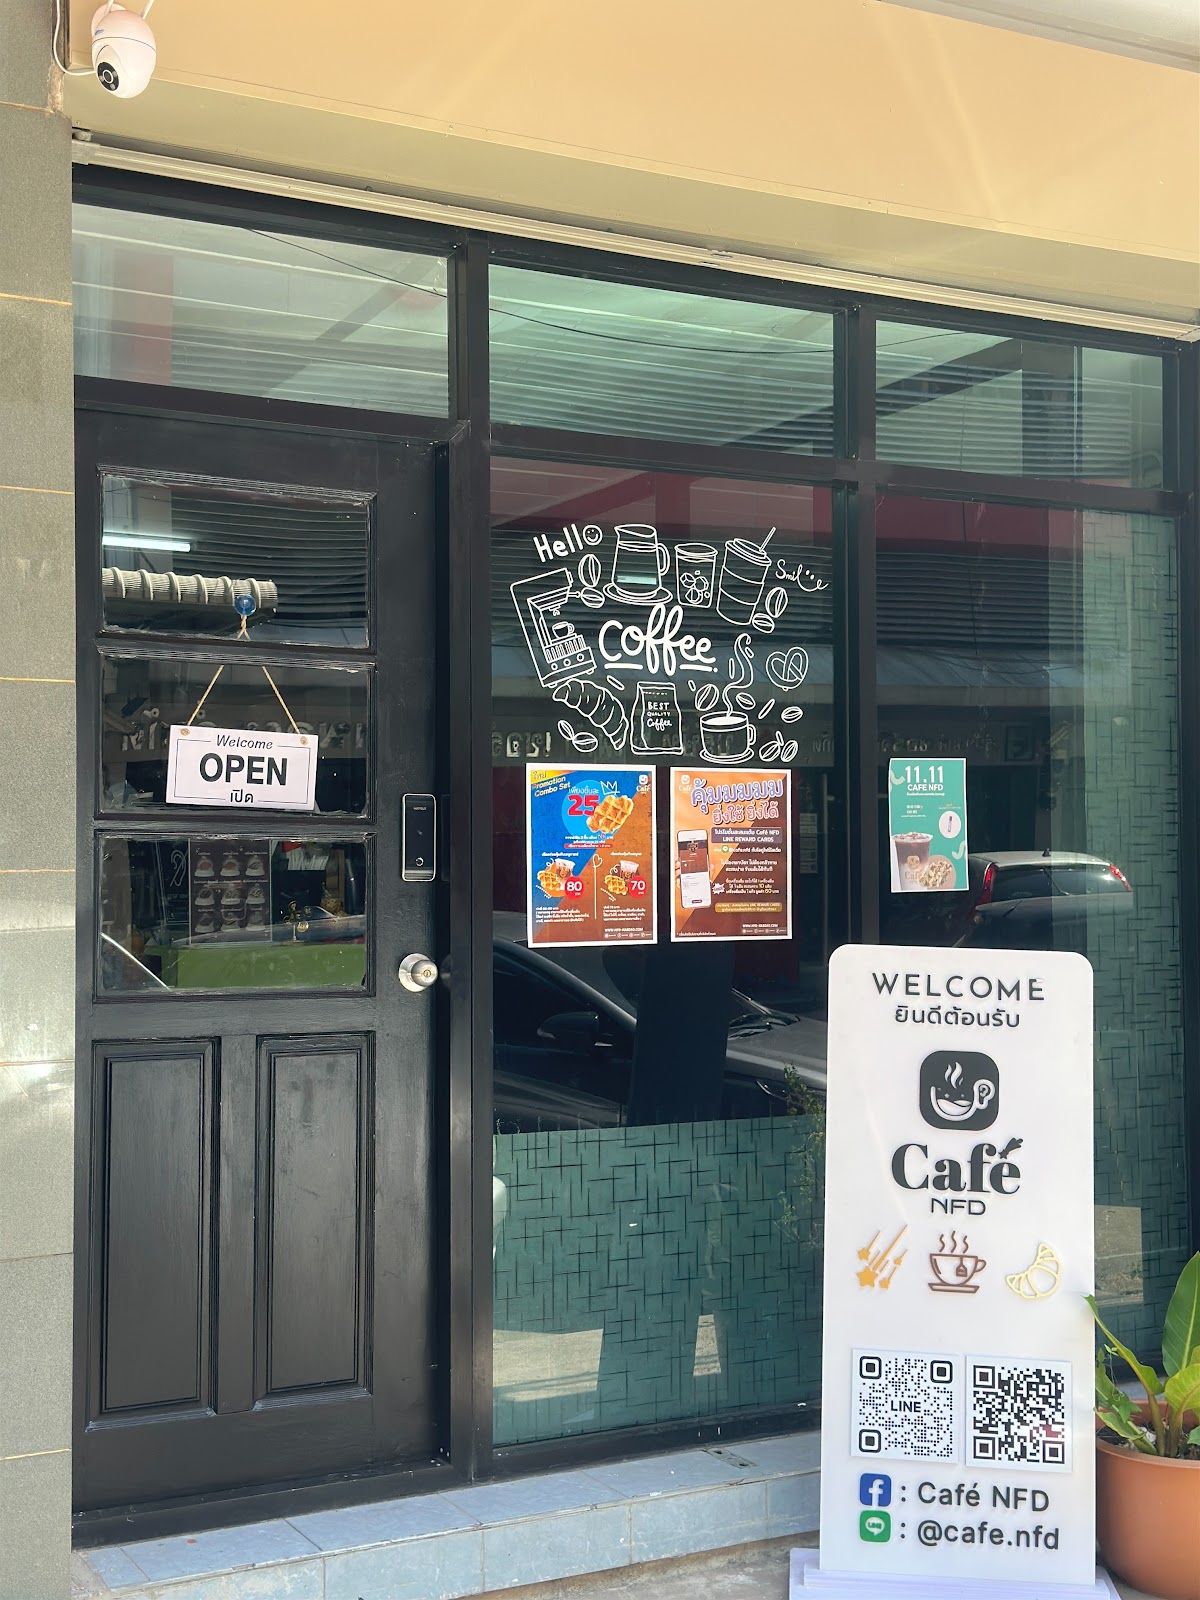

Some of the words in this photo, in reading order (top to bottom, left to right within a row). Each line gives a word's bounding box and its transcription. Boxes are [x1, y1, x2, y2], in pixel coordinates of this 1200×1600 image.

[775, 558, 830, 592] Smile
[647, 701, 670, 711] BEST
[646, 718, 673, 731] Coffee
[216, 733, 274, 751] Welcome
[199, 751, 289, 787] OPEN
[904, 765, 944, 784] 11.11
[229, 788, 255, 804] เปิด
[534, 786, 559, 798] Combo
[558, 781, 571, 791] Set
[907, 783, 928, 791] CAFE
[928, 783, 944, 791] NFD
[568, 793, 600, 816] 25
[566, 881, 583, 892] 80
[630, 880, 646, 891] 70
[872, 971, 1045, 1001] WELCOME
[894, 1005, 1021, 1028] ยินดีต้อนรับ
[890, 1136, 1024, 1195] Café
[930, 1197, 987, 1216] NFD
[890, 1400, 922, 1413] LINE
[917, 1481, 981, 1507] Café
[992, 1485, 1050, 1512] NFD
[917, 1519, 1060, 1550] @cafe.nfd
